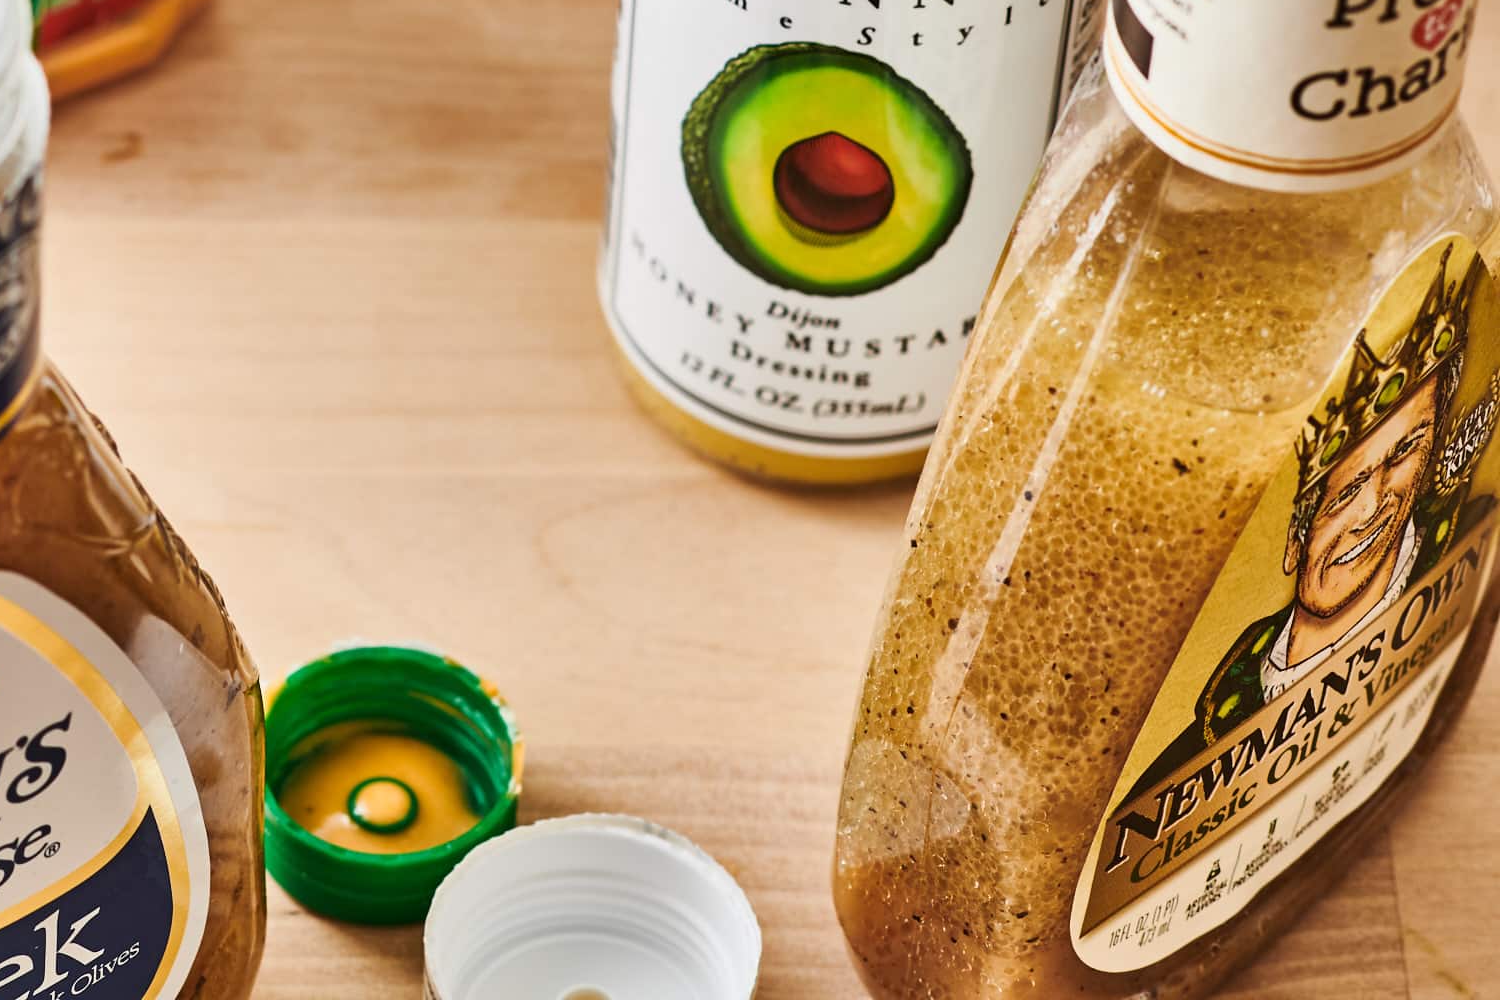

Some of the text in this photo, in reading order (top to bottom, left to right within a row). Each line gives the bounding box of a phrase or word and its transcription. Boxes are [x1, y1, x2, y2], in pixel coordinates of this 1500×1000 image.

[766, 300, 842, 331] Dijon
[785, 314, 978, 360] MUSTAR
[731, 340, 872, 389] Dressing
[1105, 631, 1386, 873] NEWMAN'S
[1130, 782, 1257, 885] Classic
[1267, 727, 1320, 786] Oil
[1327, 700, 1356, 739] &
[1363, 607, 1460, 707] Vinegar
[71, 941, 140, 996] Olives
